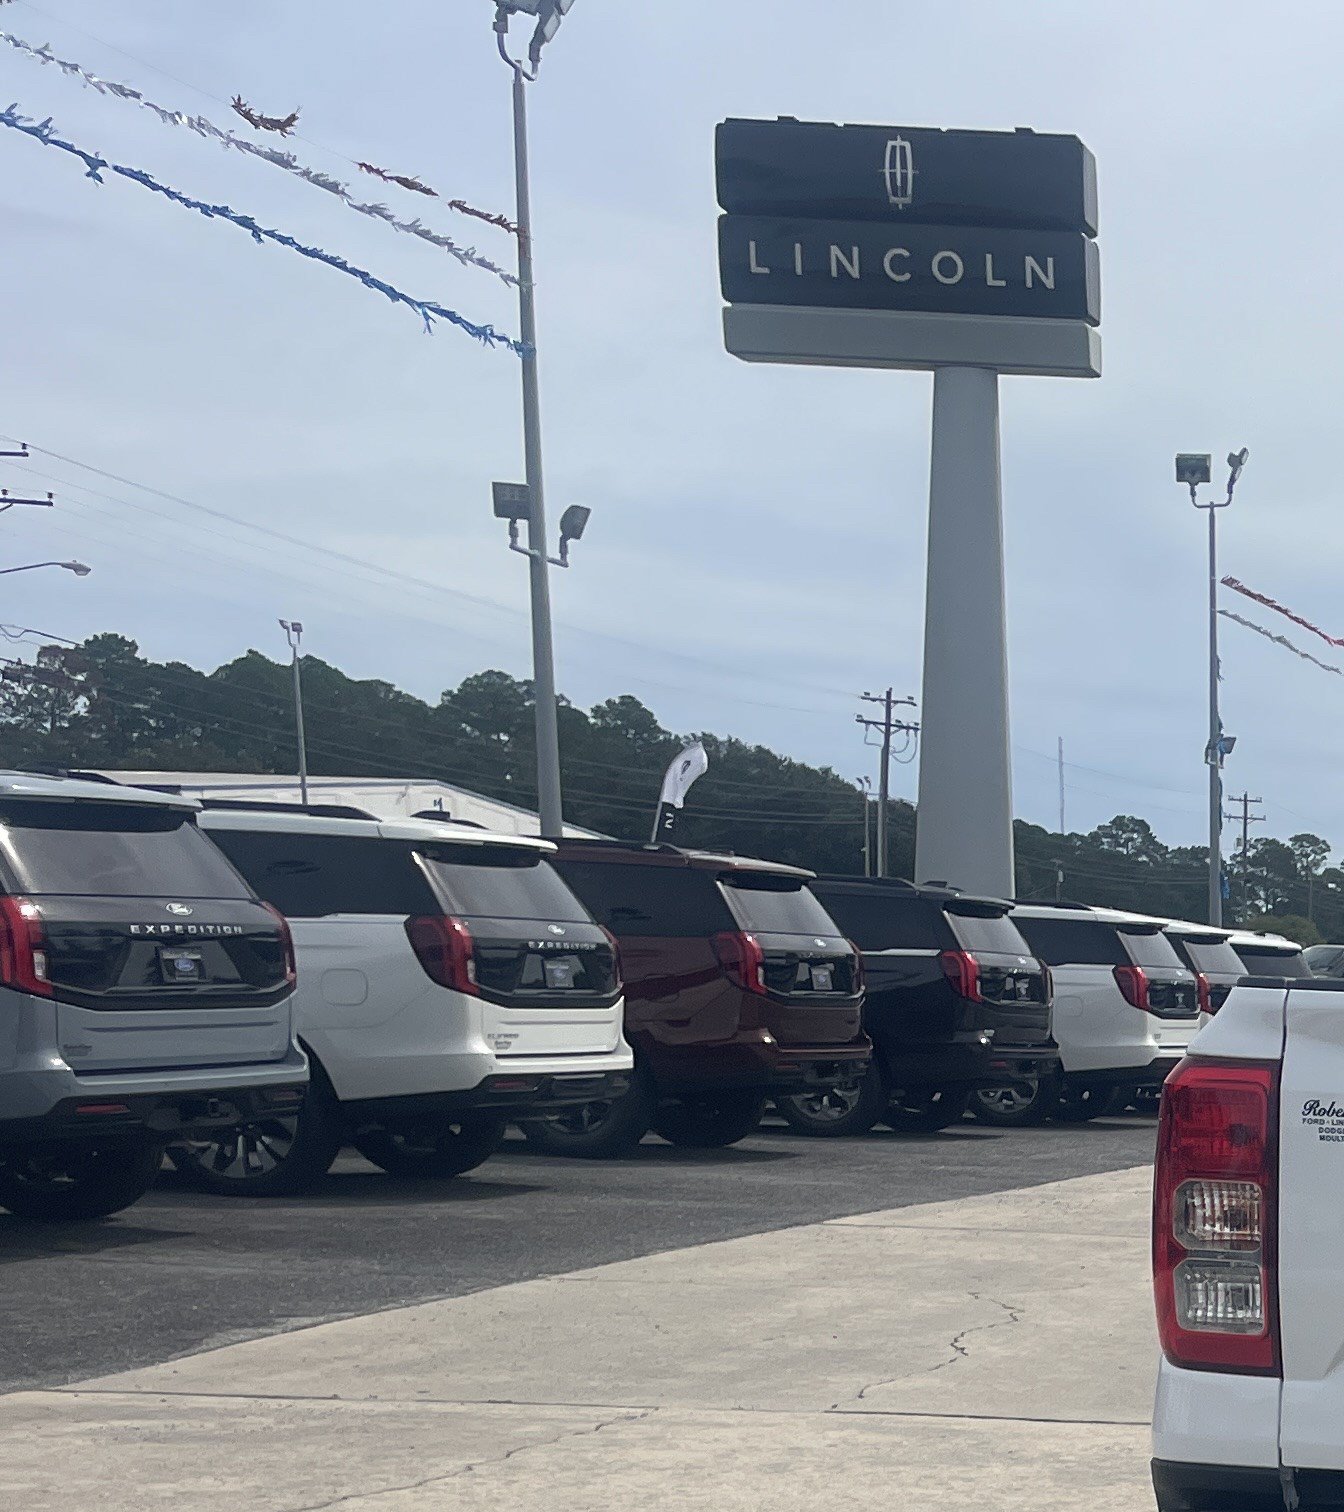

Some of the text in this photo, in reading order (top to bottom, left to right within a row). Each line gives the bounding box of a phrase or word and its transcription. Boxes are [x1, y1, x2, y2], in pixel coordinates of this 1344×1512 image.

[748, 239, 1056, 290] LINCOLN
[130, 924, 243, 934] EXPEDITION
[1302, 1118, 1325, 1126] FORD
